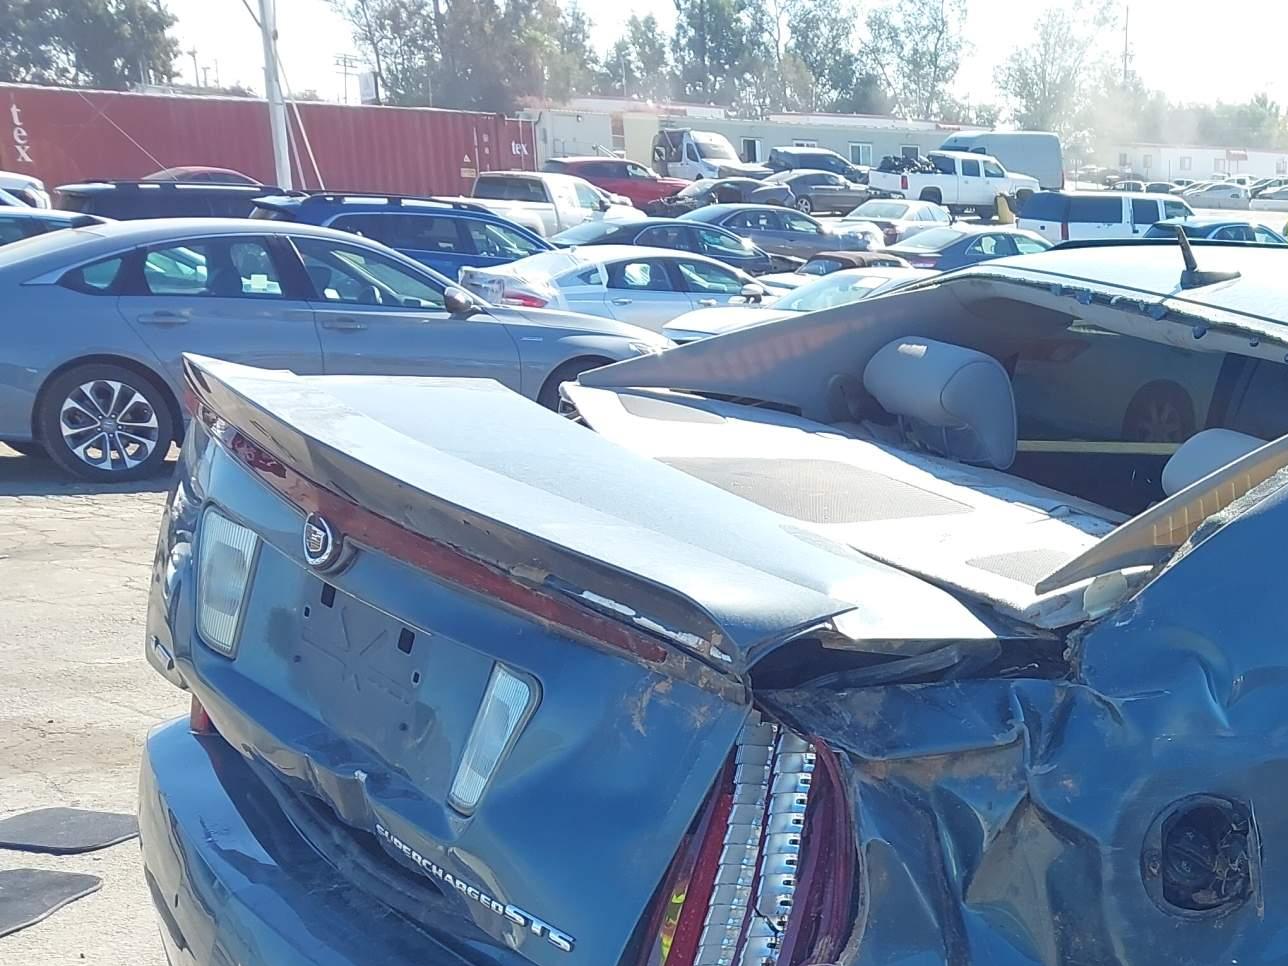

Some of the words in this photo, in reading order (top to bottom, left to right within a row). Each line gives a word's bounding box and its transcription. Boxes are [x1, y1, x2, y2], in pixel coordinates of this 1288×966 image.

[10, 103, 33, 162] tex
[375, 823, 504, 917] SUPERCHARGED
[504, 904, 577, 953] STS
